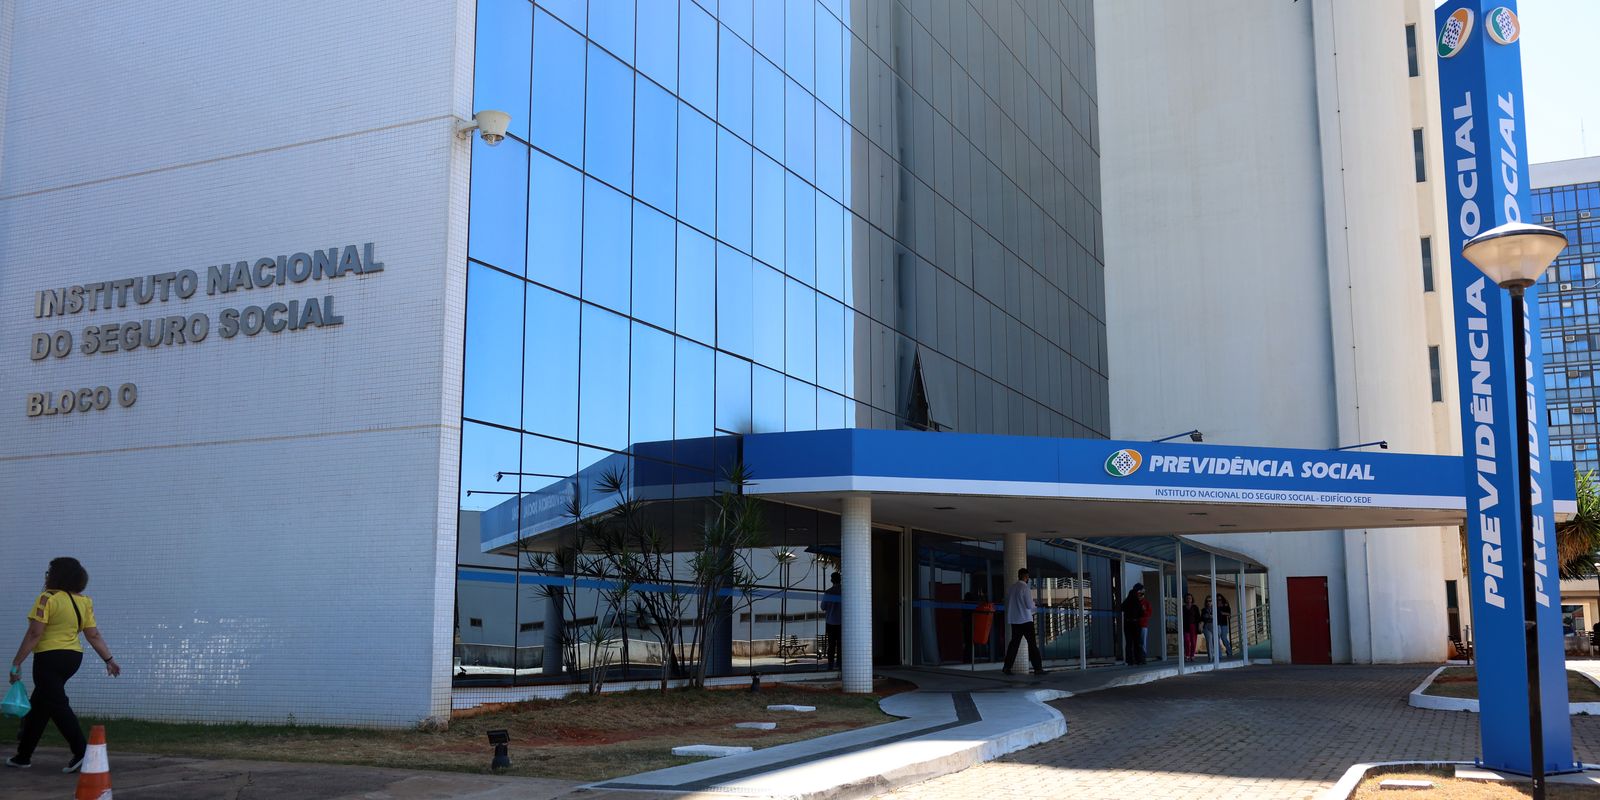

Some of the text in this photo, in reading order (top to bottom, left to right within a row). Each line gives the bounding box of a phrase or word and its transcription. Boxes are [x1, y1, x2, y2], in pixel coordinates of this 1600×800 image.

[1453, 91, 1481, 250] OCIAL
[1498, 91, 1521, 224] OCIAL
[34, 242, 385, 318] INSTITUTO NACIONAL
[30, 295, 345, 361] DO SEGURO SOCIAL
[26, 382, 137, 417] BLOCO O
[1149, 455, 1375, 481] PREVIDÊNCIA SOCIAL
[1465, 276, 1506, 609] PREVIDÊNCIA
[1155, 488, 1197, 497] INSTITUTO
[1198, 490, 1240, 499] NACIONAL
[1241, 491, 1254, 499] DO
[1255, 492, 1287, 501] SEGURO
[1288, 493, 1315, 502] SOCIAL
[1320, 493, 1353, 503] EDIFÍCIO
[1353, 495, 1372, 504] SEDE
